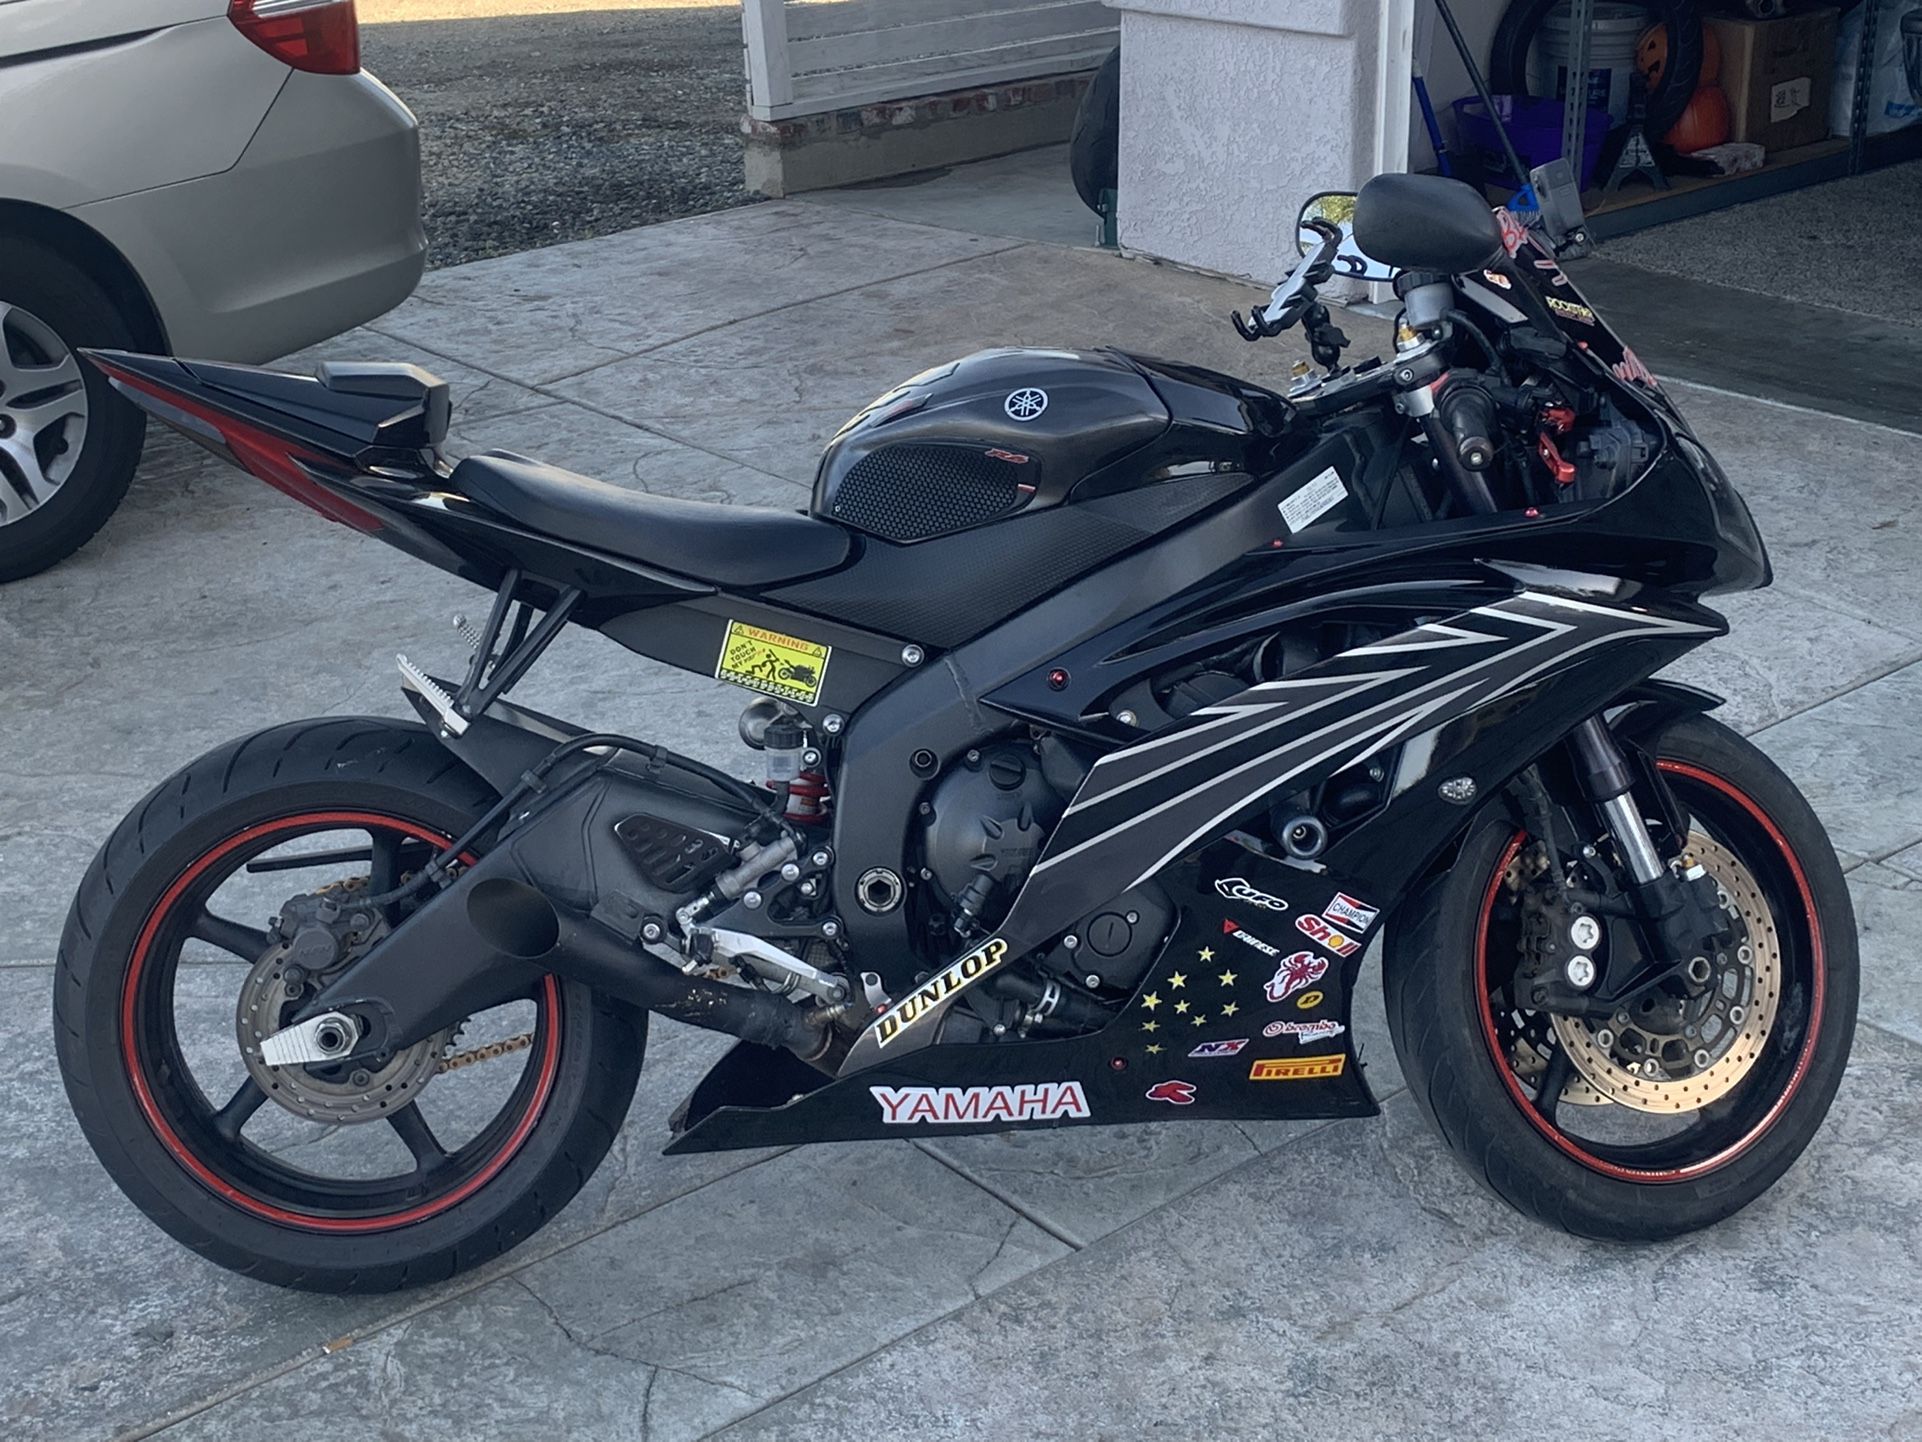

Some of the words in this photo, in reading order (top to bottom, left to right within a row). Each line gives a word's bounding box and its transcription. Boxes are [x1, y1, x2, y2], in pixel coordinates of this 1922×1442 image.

[748, 627, 809, 651] WARNING
[731, 646, 756, 662] TOUCH
[1332, 902, 1369, 923] CHAMPION
[875, 940, 1004, 1043] DUNLOP
[1253, 1058, 1342, 1078] PIRELLI
[878, 1084, 1084, 1121] YAMAHA
